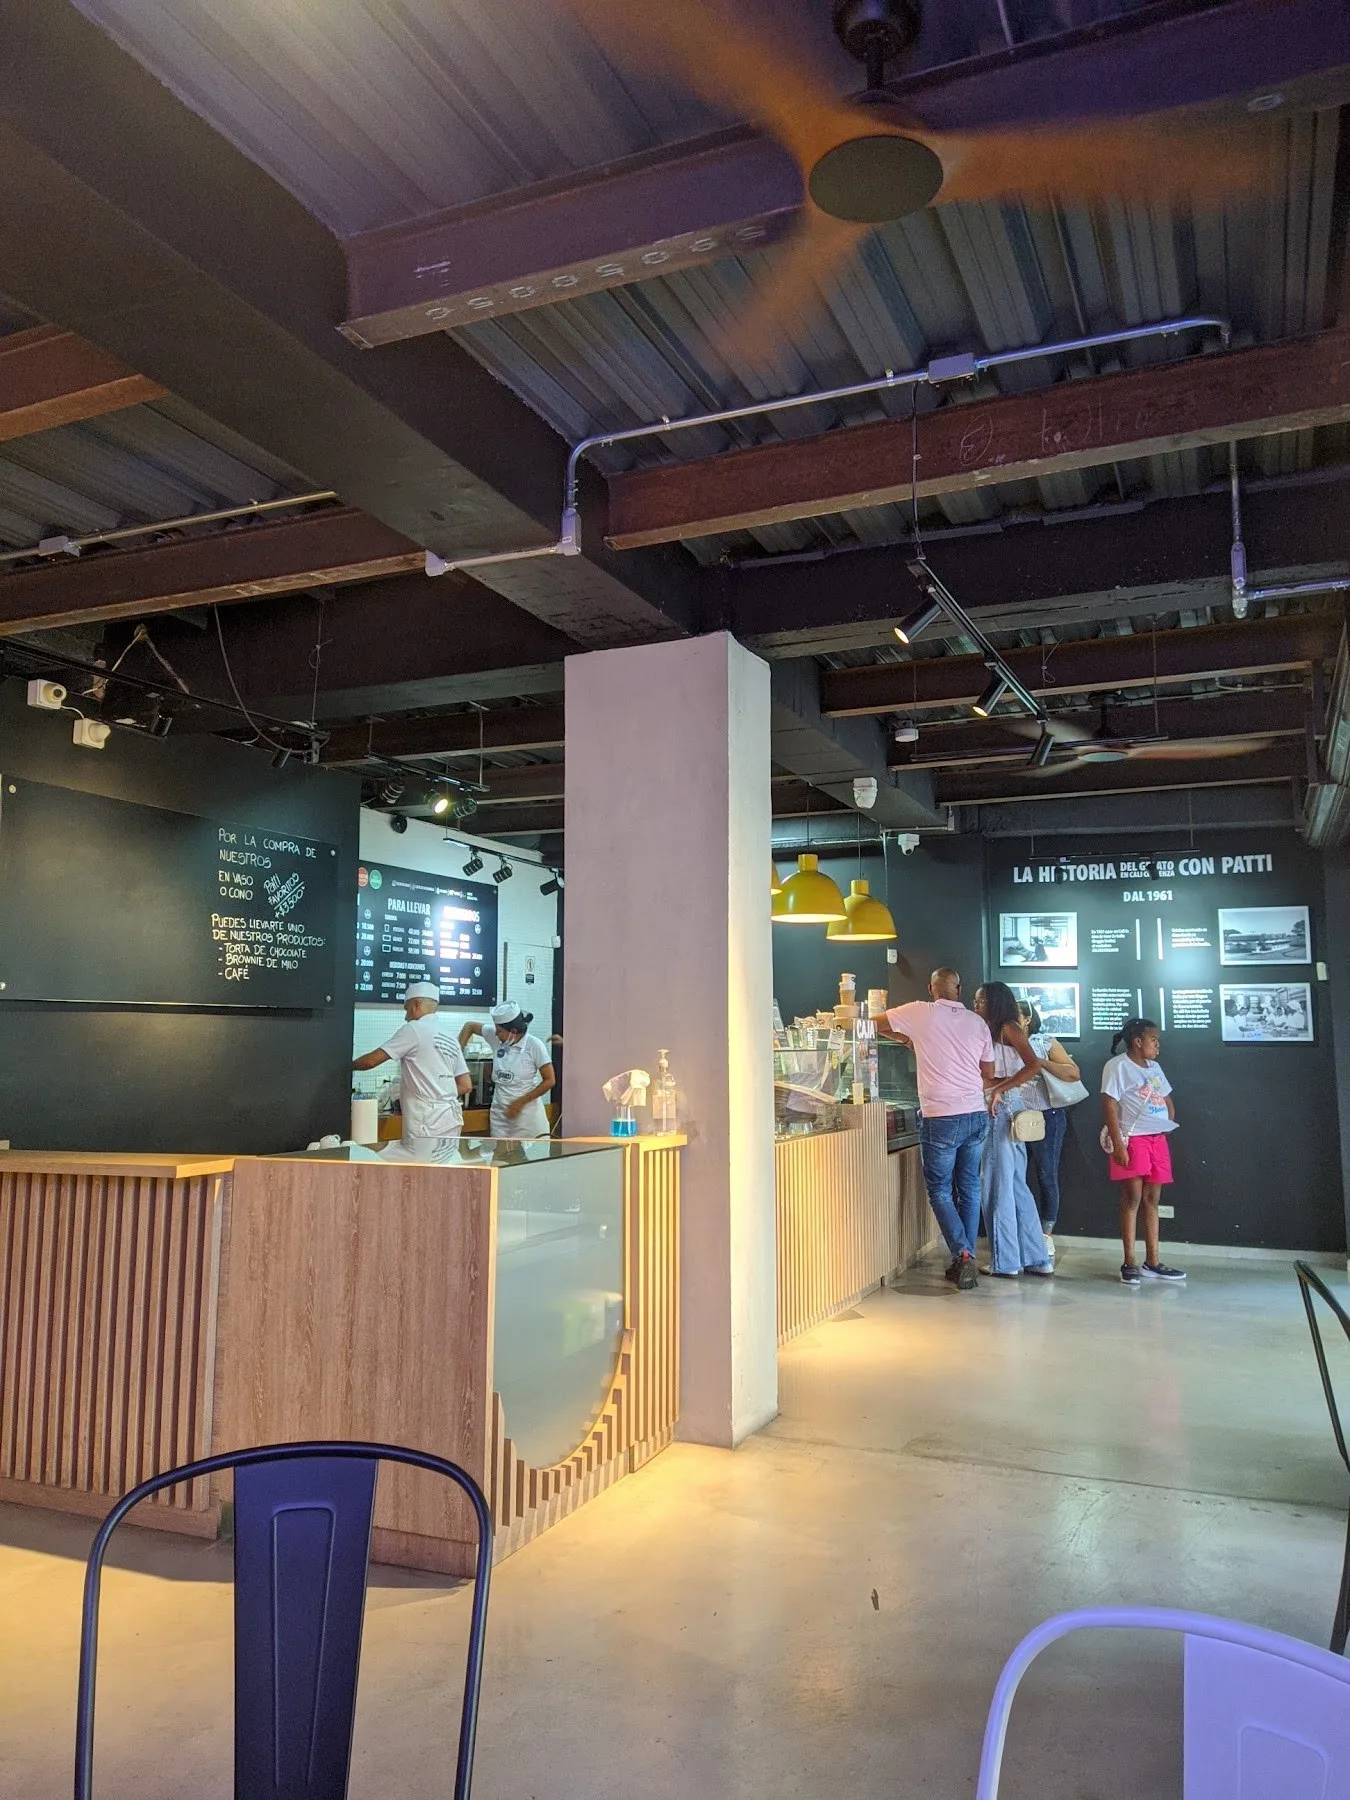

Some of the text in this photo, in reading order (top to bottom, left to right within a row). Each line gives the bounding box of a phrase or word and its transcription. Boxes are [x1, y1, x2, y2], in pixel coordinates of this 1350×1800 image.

[218, 828, 316, 858] POR LA COMPRA DE
[219, 849, 271, 869] NUESTROS
[1120, 860, 1175, 871] DEL GATO
[1178, 853, 1273, 876] CON PATTI
[218, 870, 253, 886] EN VASO
[1013, 866, 1034, 883] LA
[1129, 870, 1143, 878] CALI
[219, 887, 253, 901] O CONO
[1123, 890, 1173, 902] DAL 1961
[387, 898, 406, 912] PARA
[407, 901, 431, 916] LLEVAR
[211, 913, 247, 928] PUEDES
[287, 922, 305, 934] UNO
[212, 929, 228, 940] DE
[229, 930, 273, 943] NUESTROS
[253, 944, 266, 956] DE
[266, 957, 278, 968] DE
[856, 1019, 877, 1039] CAJA
